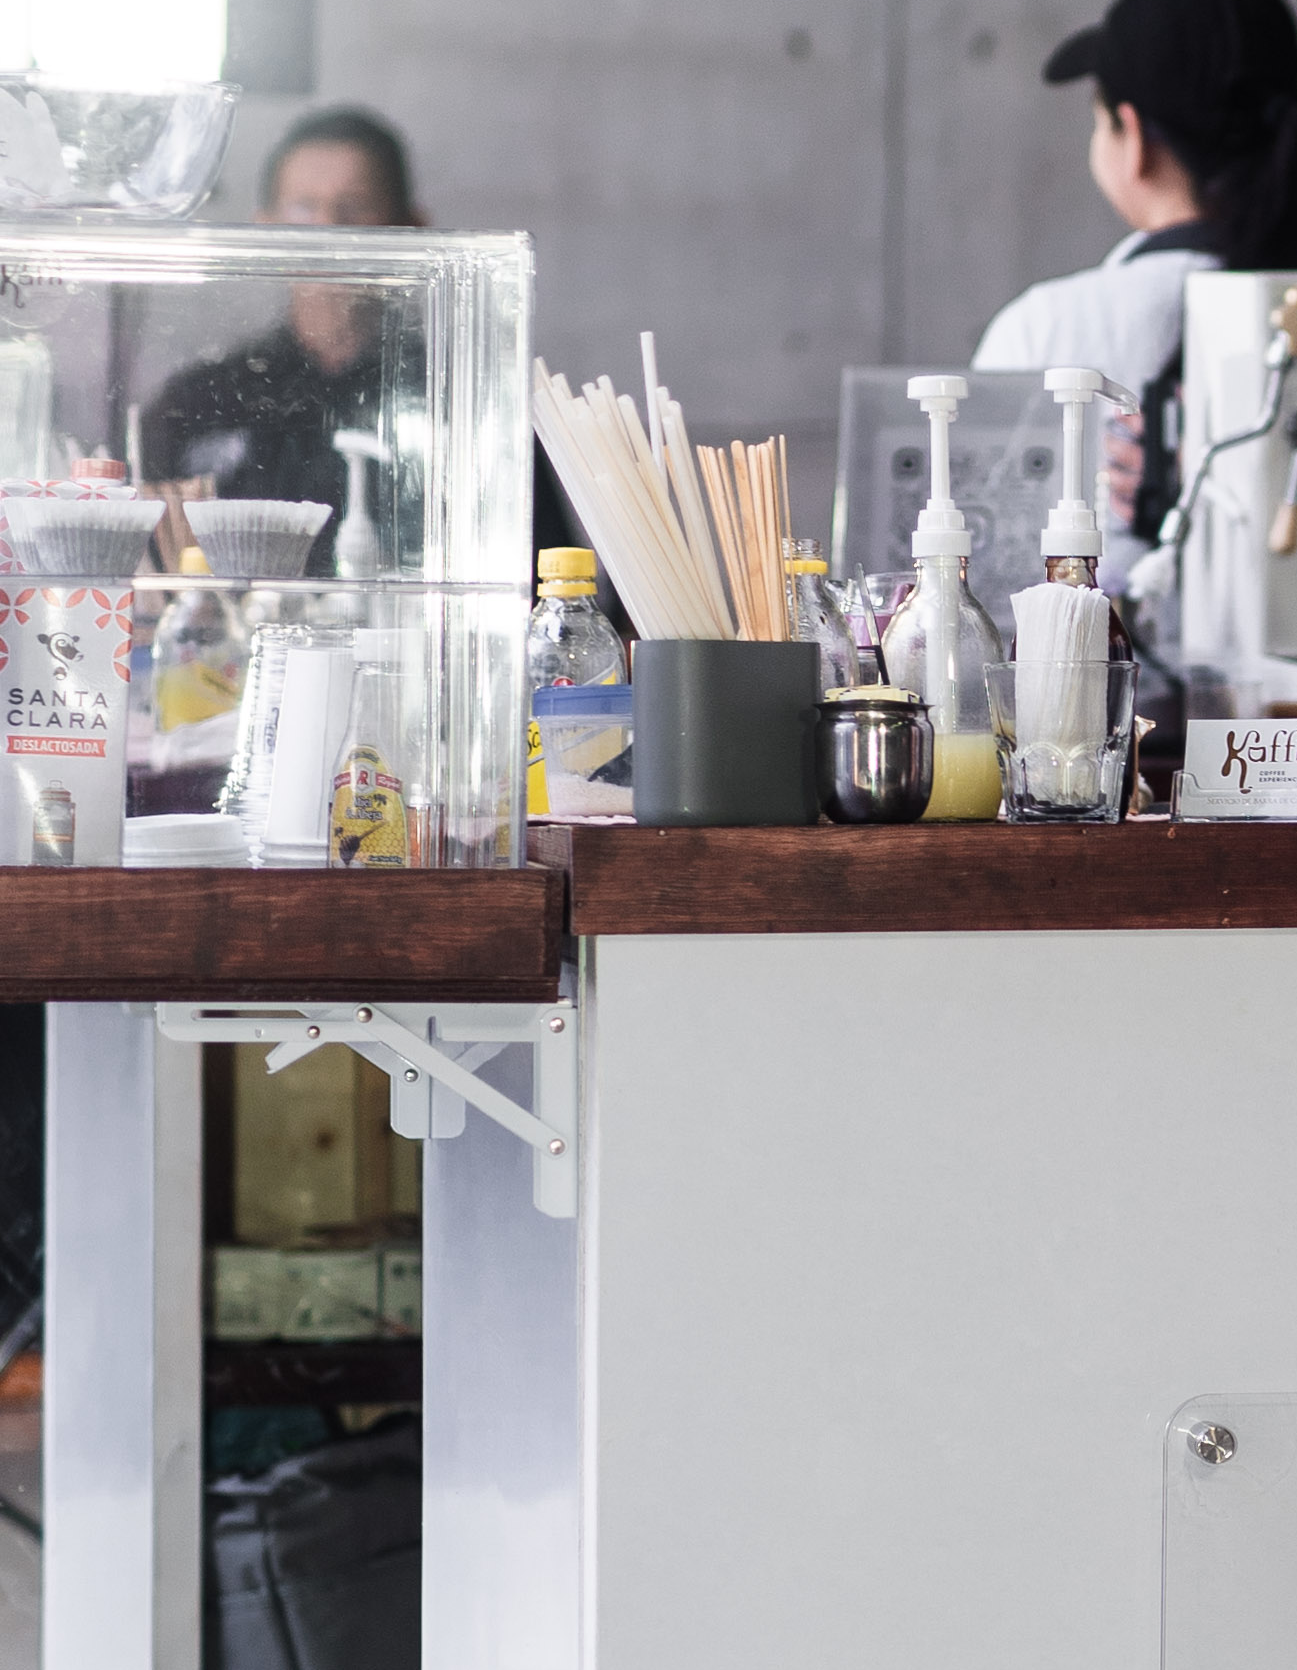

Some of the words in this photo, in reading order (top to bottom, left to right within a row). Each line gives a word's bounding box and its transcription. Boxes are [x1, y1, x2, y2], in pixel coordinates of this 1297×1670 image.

[8, 688, 108, 708] SANTA
[7, 709, 107, 730] CLARA
[13, 739, 100, 754] DESLACTOSADA
